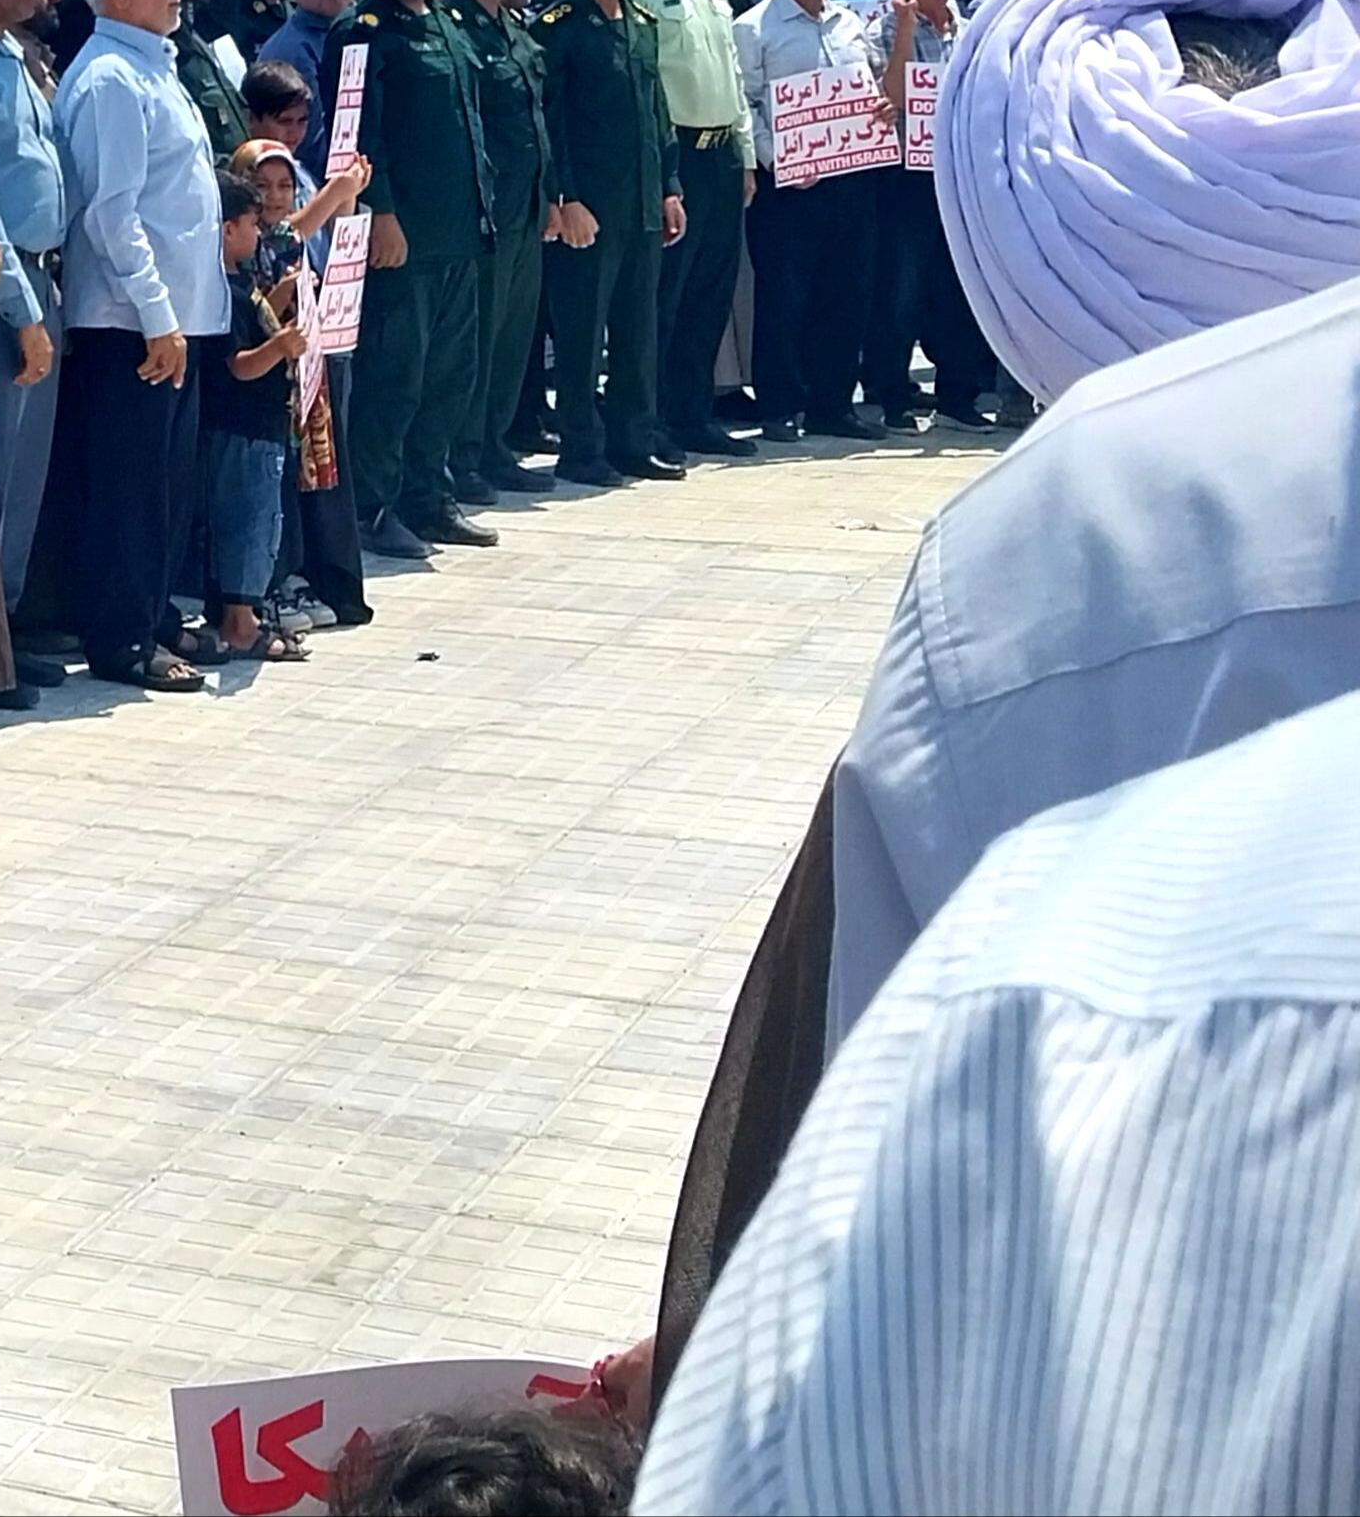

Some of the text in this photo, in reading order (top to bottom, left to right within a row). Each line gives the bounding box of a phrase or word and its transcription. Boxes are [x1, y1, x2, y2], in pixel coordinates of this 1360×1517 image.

[775, 72, 822, 108] آمریکا
[827, 78, 842, 101] بر
[777, 109, 814, 130] DOWN
[815, 102, 851, 121] WITH
[912, 100, 934, 113] DO
[776, 124, 833, 164] اسرائیل
[837, 129, 851, 152] بر
[777, 147, 900, 182] DOWN WITH ISRAEL
[909, 152, 931, 165] DO
